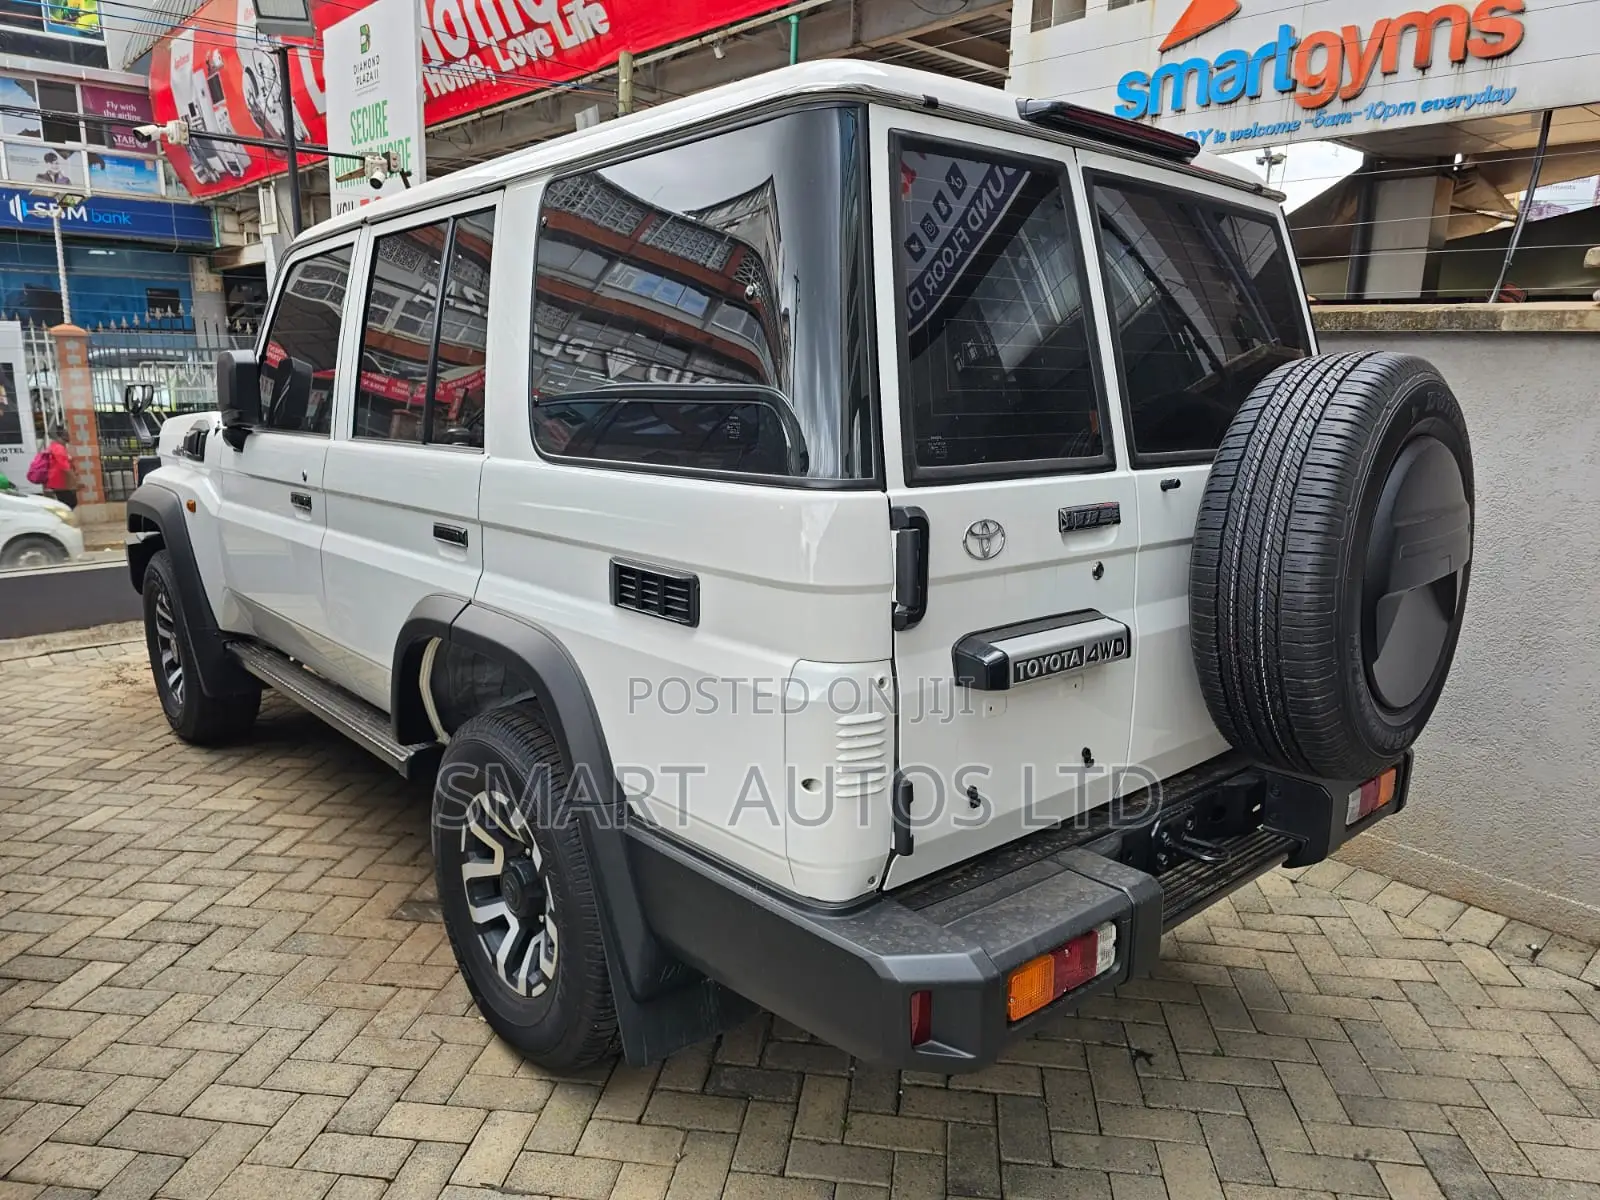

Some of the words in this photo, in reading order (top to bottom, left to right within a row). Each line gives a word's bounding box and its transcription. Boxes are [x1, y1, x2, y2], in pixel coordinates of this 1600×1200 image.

[488, 27, 555, 72] Love
[550, 0, 610, 50] Life
[353, 54, 380, 75] DIAMOND
[1114, 0, 1525, 120] smartgyms
[356, 70, 374, 87] PLAZA
[106, 101, 119, 111] Fly
[120, 104, 137, 112] with
[350, 99, 389, 146] SECURE
[1213, 129, 1227, 144] is
[1230, 119, 1301, 142] welcome
[1420, 85, 1518, 113] everyday
[91, 207, 132, 225] bank
[0, 447, 24, 455] OTEL
[1016, 648, 1082, 681] TOYOTA
[1087, 637, 1126, 663] 4WD
